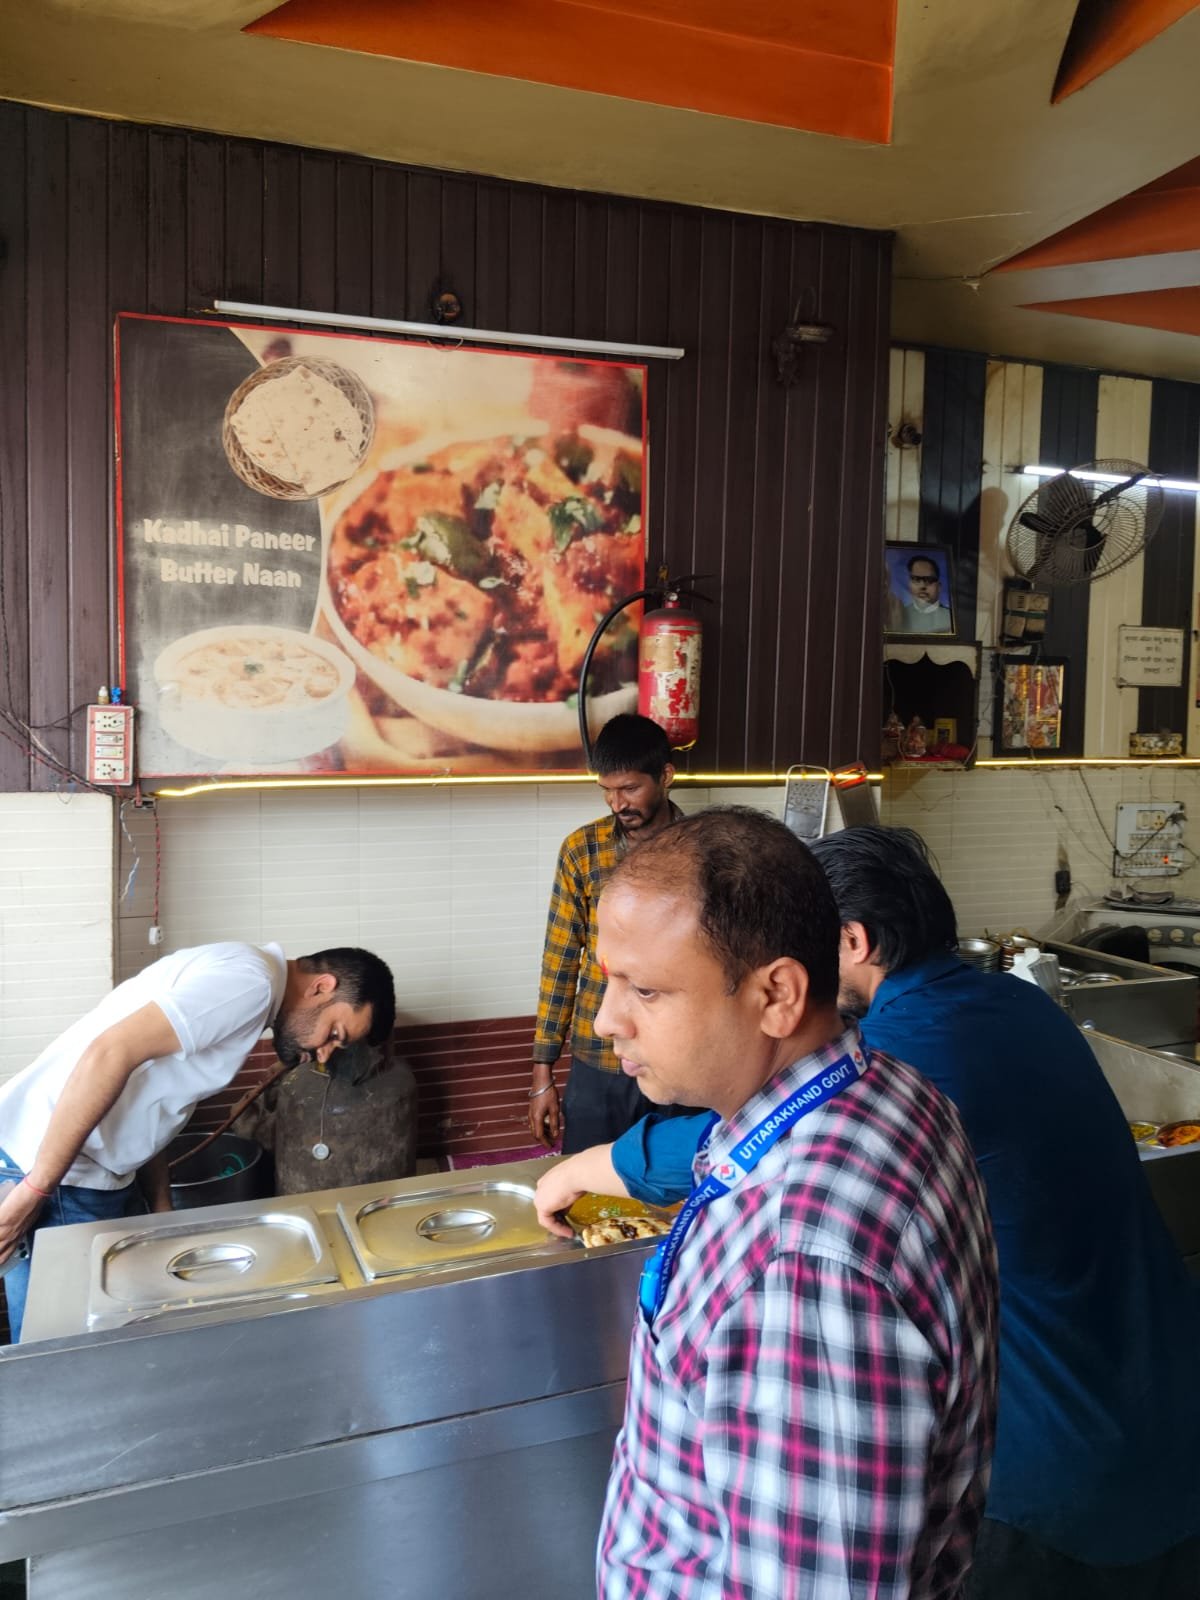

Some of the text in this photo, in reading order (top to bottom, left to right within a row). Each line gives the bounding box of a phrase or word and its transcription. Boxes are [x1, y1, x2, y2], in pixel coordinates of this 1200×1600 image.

[143, 518, 316, 552] Kadhai Paneer
[160, 557, 301, 588] Butter Naan
[739, 1085, 822, 1159] UTTARAKHAND
